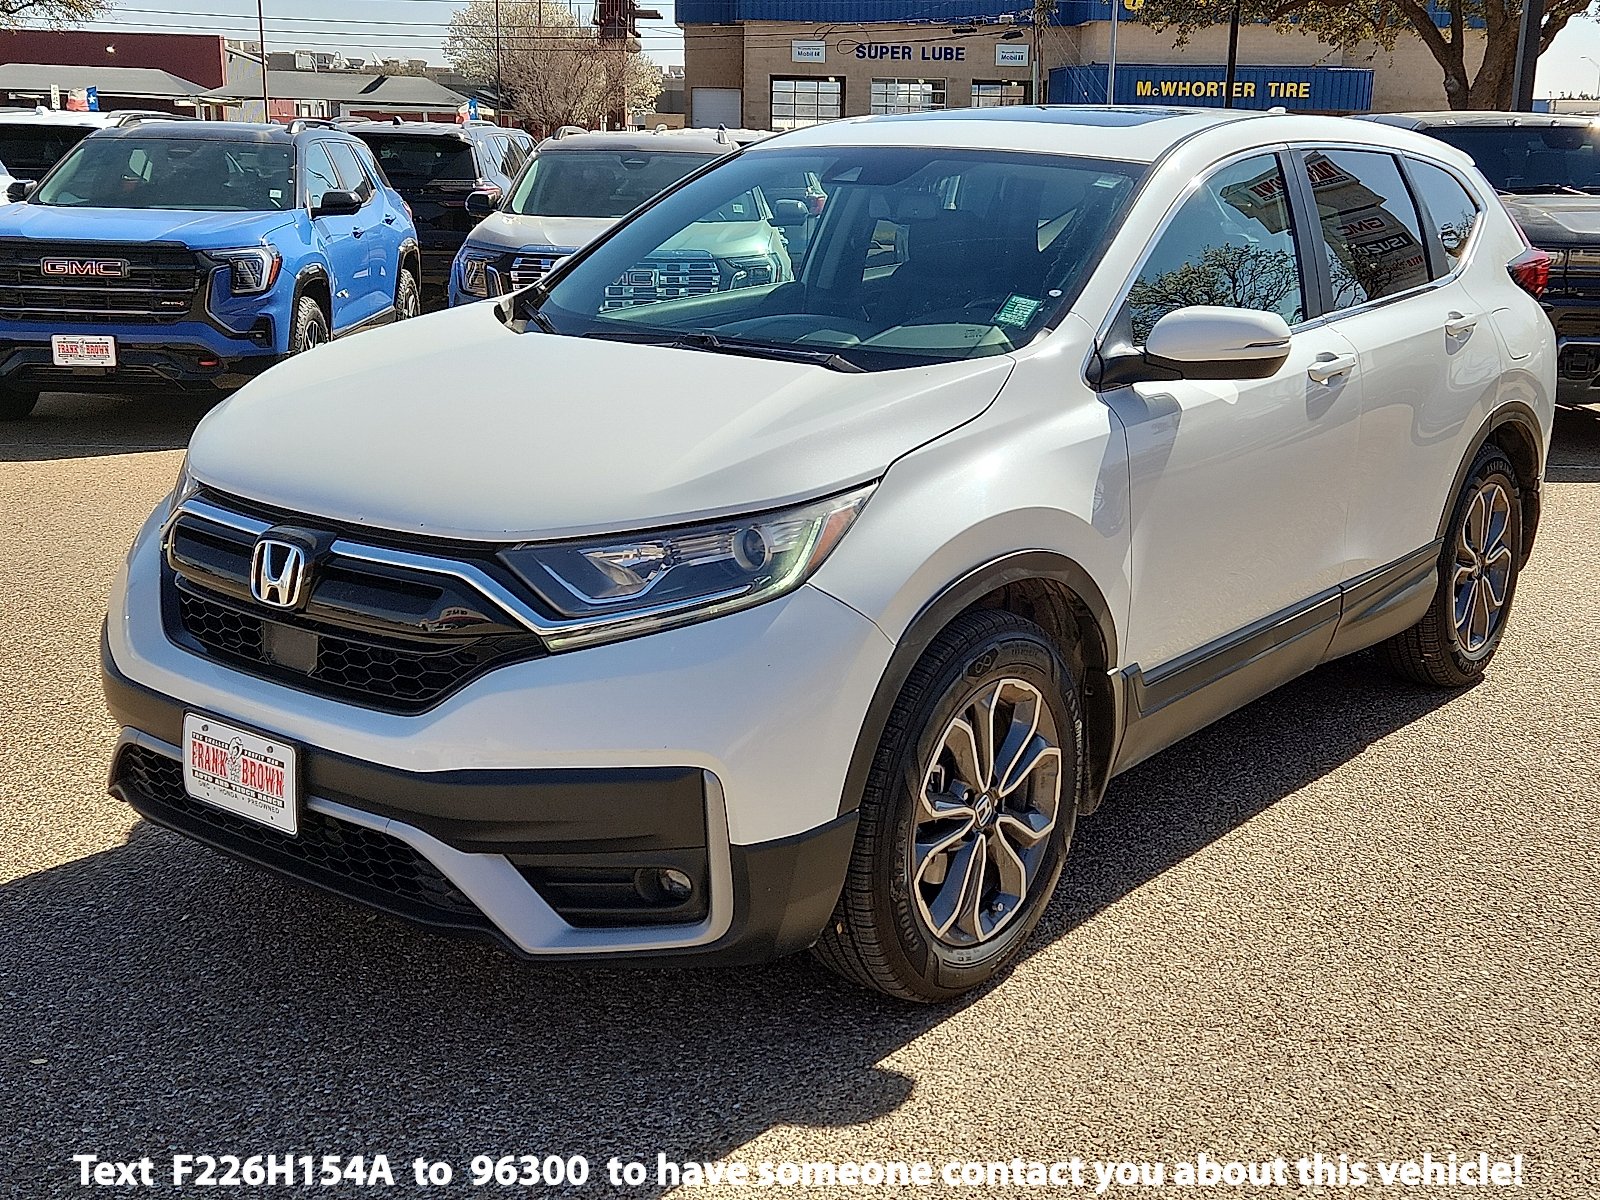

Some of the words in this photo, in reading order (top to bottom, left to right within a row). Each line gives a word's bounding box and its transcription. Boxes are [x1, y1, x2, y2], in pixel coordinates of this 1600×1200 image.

[855, 45, 913, 61] SUPER
[920, 46, 966, 62] LUBE
[1268, 82, 1311, 98] TIRE
[44, 260, 122, 276] GMC
[191, 740, 228, 779] FRANK
[241, 757, 284, 799] BROWN
[194, 770, 212, 782] AUTO
[214, 778, 228, 788] AND
[231, 783, 255, 797] TRUCK
[247, 797, 279, 814] PREOWNED
